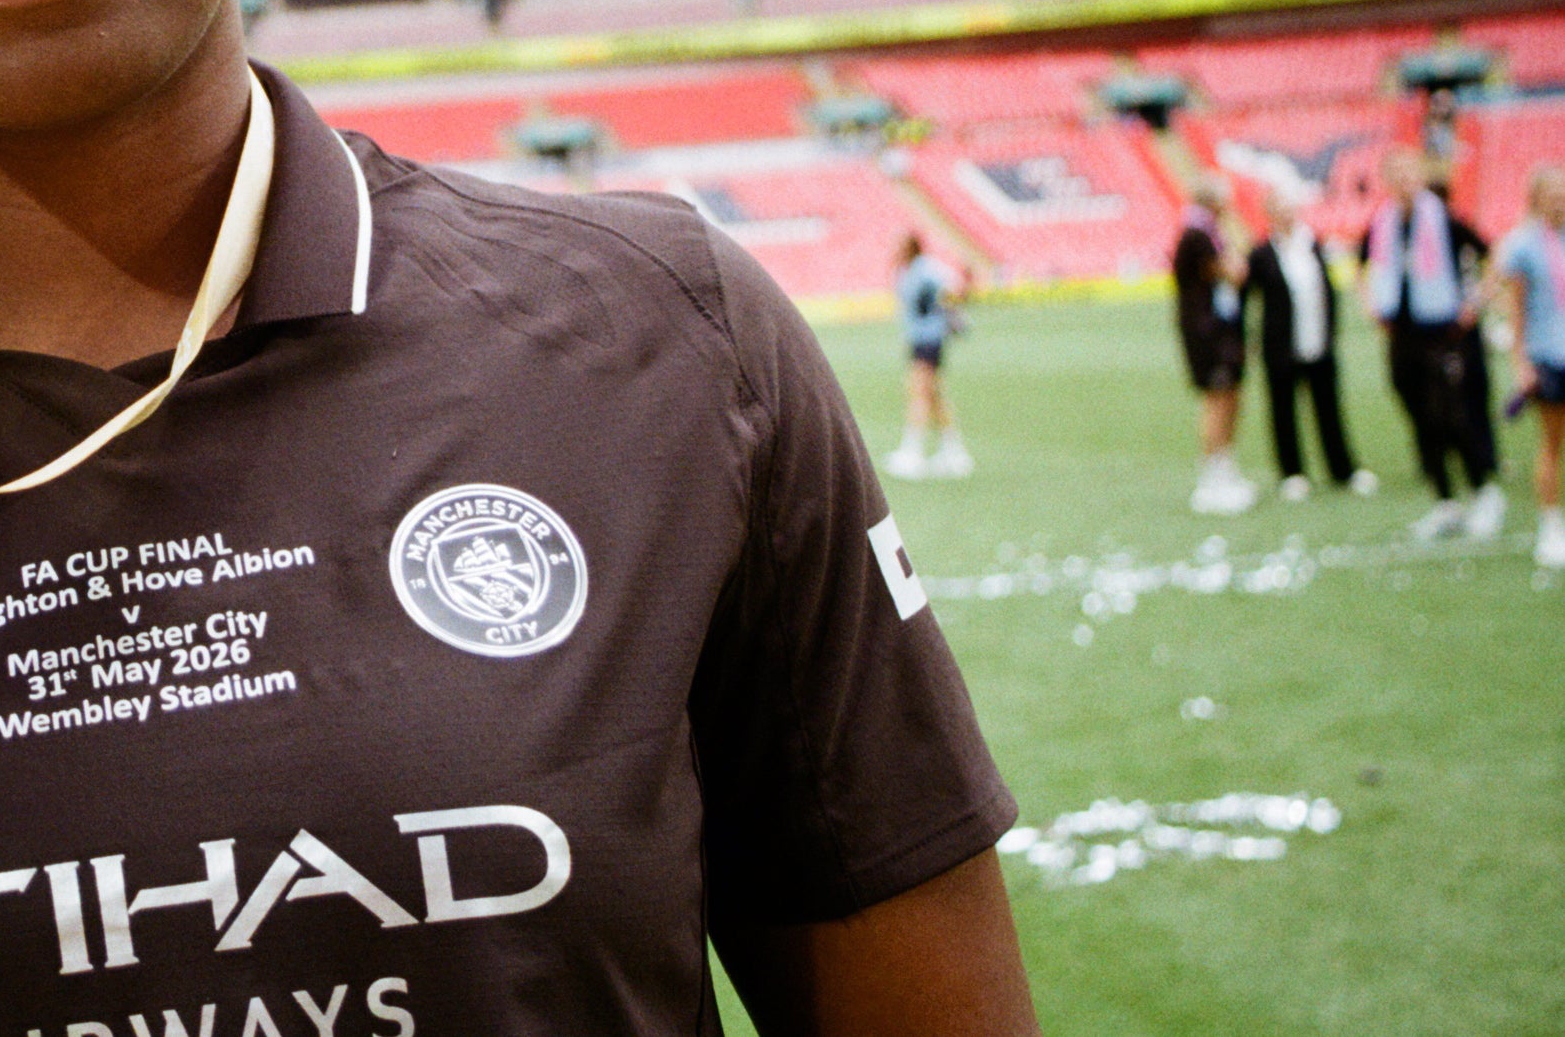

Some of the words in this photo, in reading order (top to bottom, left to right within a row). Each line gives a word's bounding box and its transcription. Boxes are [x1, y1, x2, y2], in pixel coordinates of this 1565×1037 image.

[406, 498, 552, 562] MANCHESTER
[20, 560, 59, 588] FA
[66, 546, 129, 577] CUP
[139, 532, 233, 566] FINAL
[87, 575, 112, 601] &
[121, 567, 203, 593] Hove
[212, 546, 315, 583] Albion
[122, 606, 140, 624] v
[485, 621, 538, 644] CITY
[7, 622, 197, 677] Manchester
[205, 611, 268, 639] City
[28, 668, 77, 701] 31st
[91, 658, 162, 689] May
[171, 639, 251, 675] 2026
[160, 670, 296, 712] Stadium
